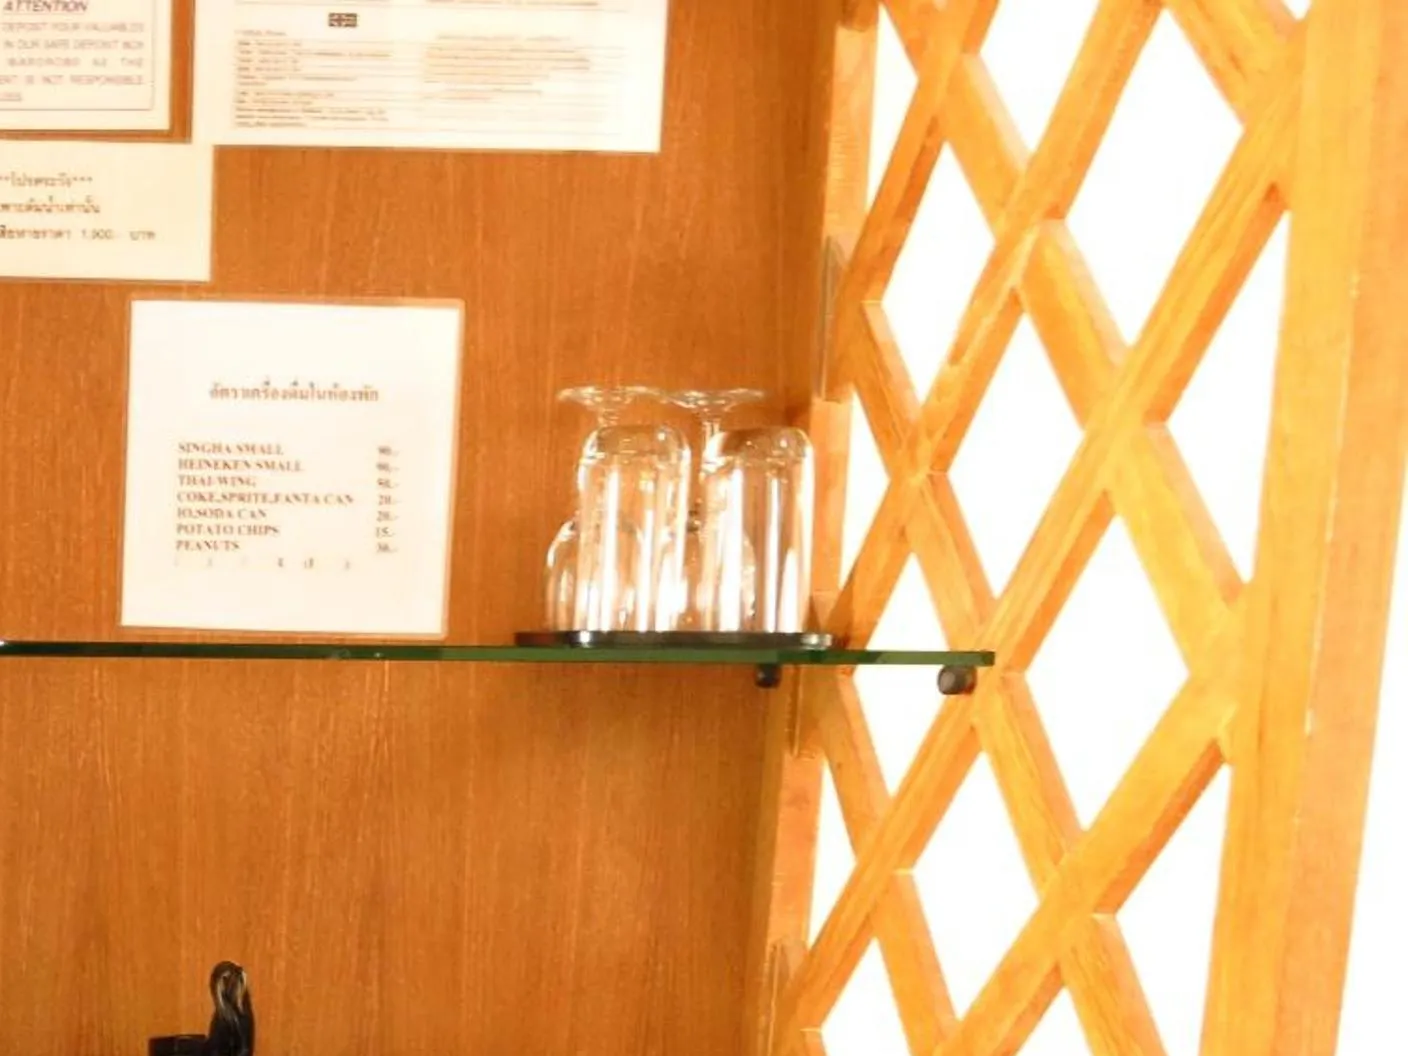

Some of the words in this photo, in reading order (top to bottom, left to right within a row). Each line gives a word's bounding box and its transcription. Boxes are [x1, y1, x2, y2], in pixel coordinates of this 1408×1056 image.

[3, 0, 87, 12] ATTENTION
[178, 442, 232, 454] SINGHA
[236, 443, 284, 455] SMALL
[178, 458, 251, 471] HEINEKEN
[255, 460, 303, 472] SMALL
[324, 494, 354, 506] CAN
[237, 509, 268, 520] CAN
[176, 523, 234, 536] POTATO
[238, 525, 281, 537] CHIPS
[176, 540, 241, 552] PEANUTS
